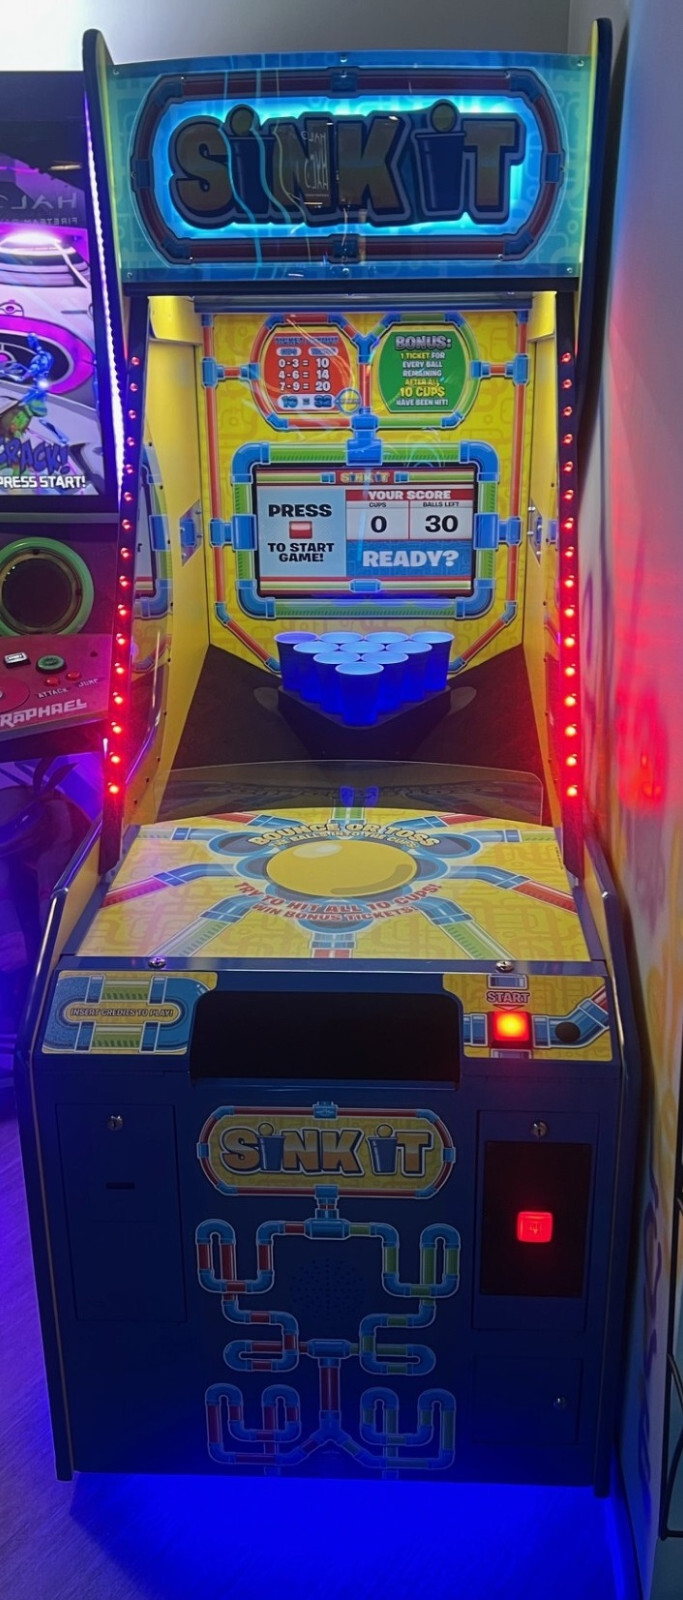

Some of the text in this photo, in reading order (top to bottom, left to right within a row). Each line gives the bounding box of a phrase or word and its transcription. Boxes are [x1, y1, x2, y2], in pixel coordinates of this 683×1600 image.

[395, 335, 452, 350] BONUS:
[316, 357, 330, 368] 10
[316, 369, 330, 380] 14
[315, 381, 331, 391] 20
[400, 386, 445, 397] 10 CUPS
[39, 476, 86, 488] START!
[368, 490, 451, 500] YOUR SCORE
[268, 503, 333, 518] PRESS
[370, 515, 388, 534] 0
[424, 514, 459, 533] 30
[268, 543, 335, 553] TO START
[278, 553, 325, 563] GAME!
[362, 550, 460, 568] READY?
[38, 688, 68, 698] ATTACK
[0, 698, 88, 728] RAPHAEL
[247, 823, 341, 846] BOUNCE
[345, 823, 381, 833] OR
[384, 826, 440, 847] TOSS
[234, 881, 264, 897] TRY
[261, 894, 287, 906] TO
[286, 900, 321, 912] HIT
[324, 903, 362, 914] ALL
[393, 883, 442, 905] CUPS!
[252, 903, 418, 922] WIN BONUS TICKETS!
[486, 990, 532, 1005] START
[71, 1008, 174, 1018] INSERT CREDITS TO PLAY!
